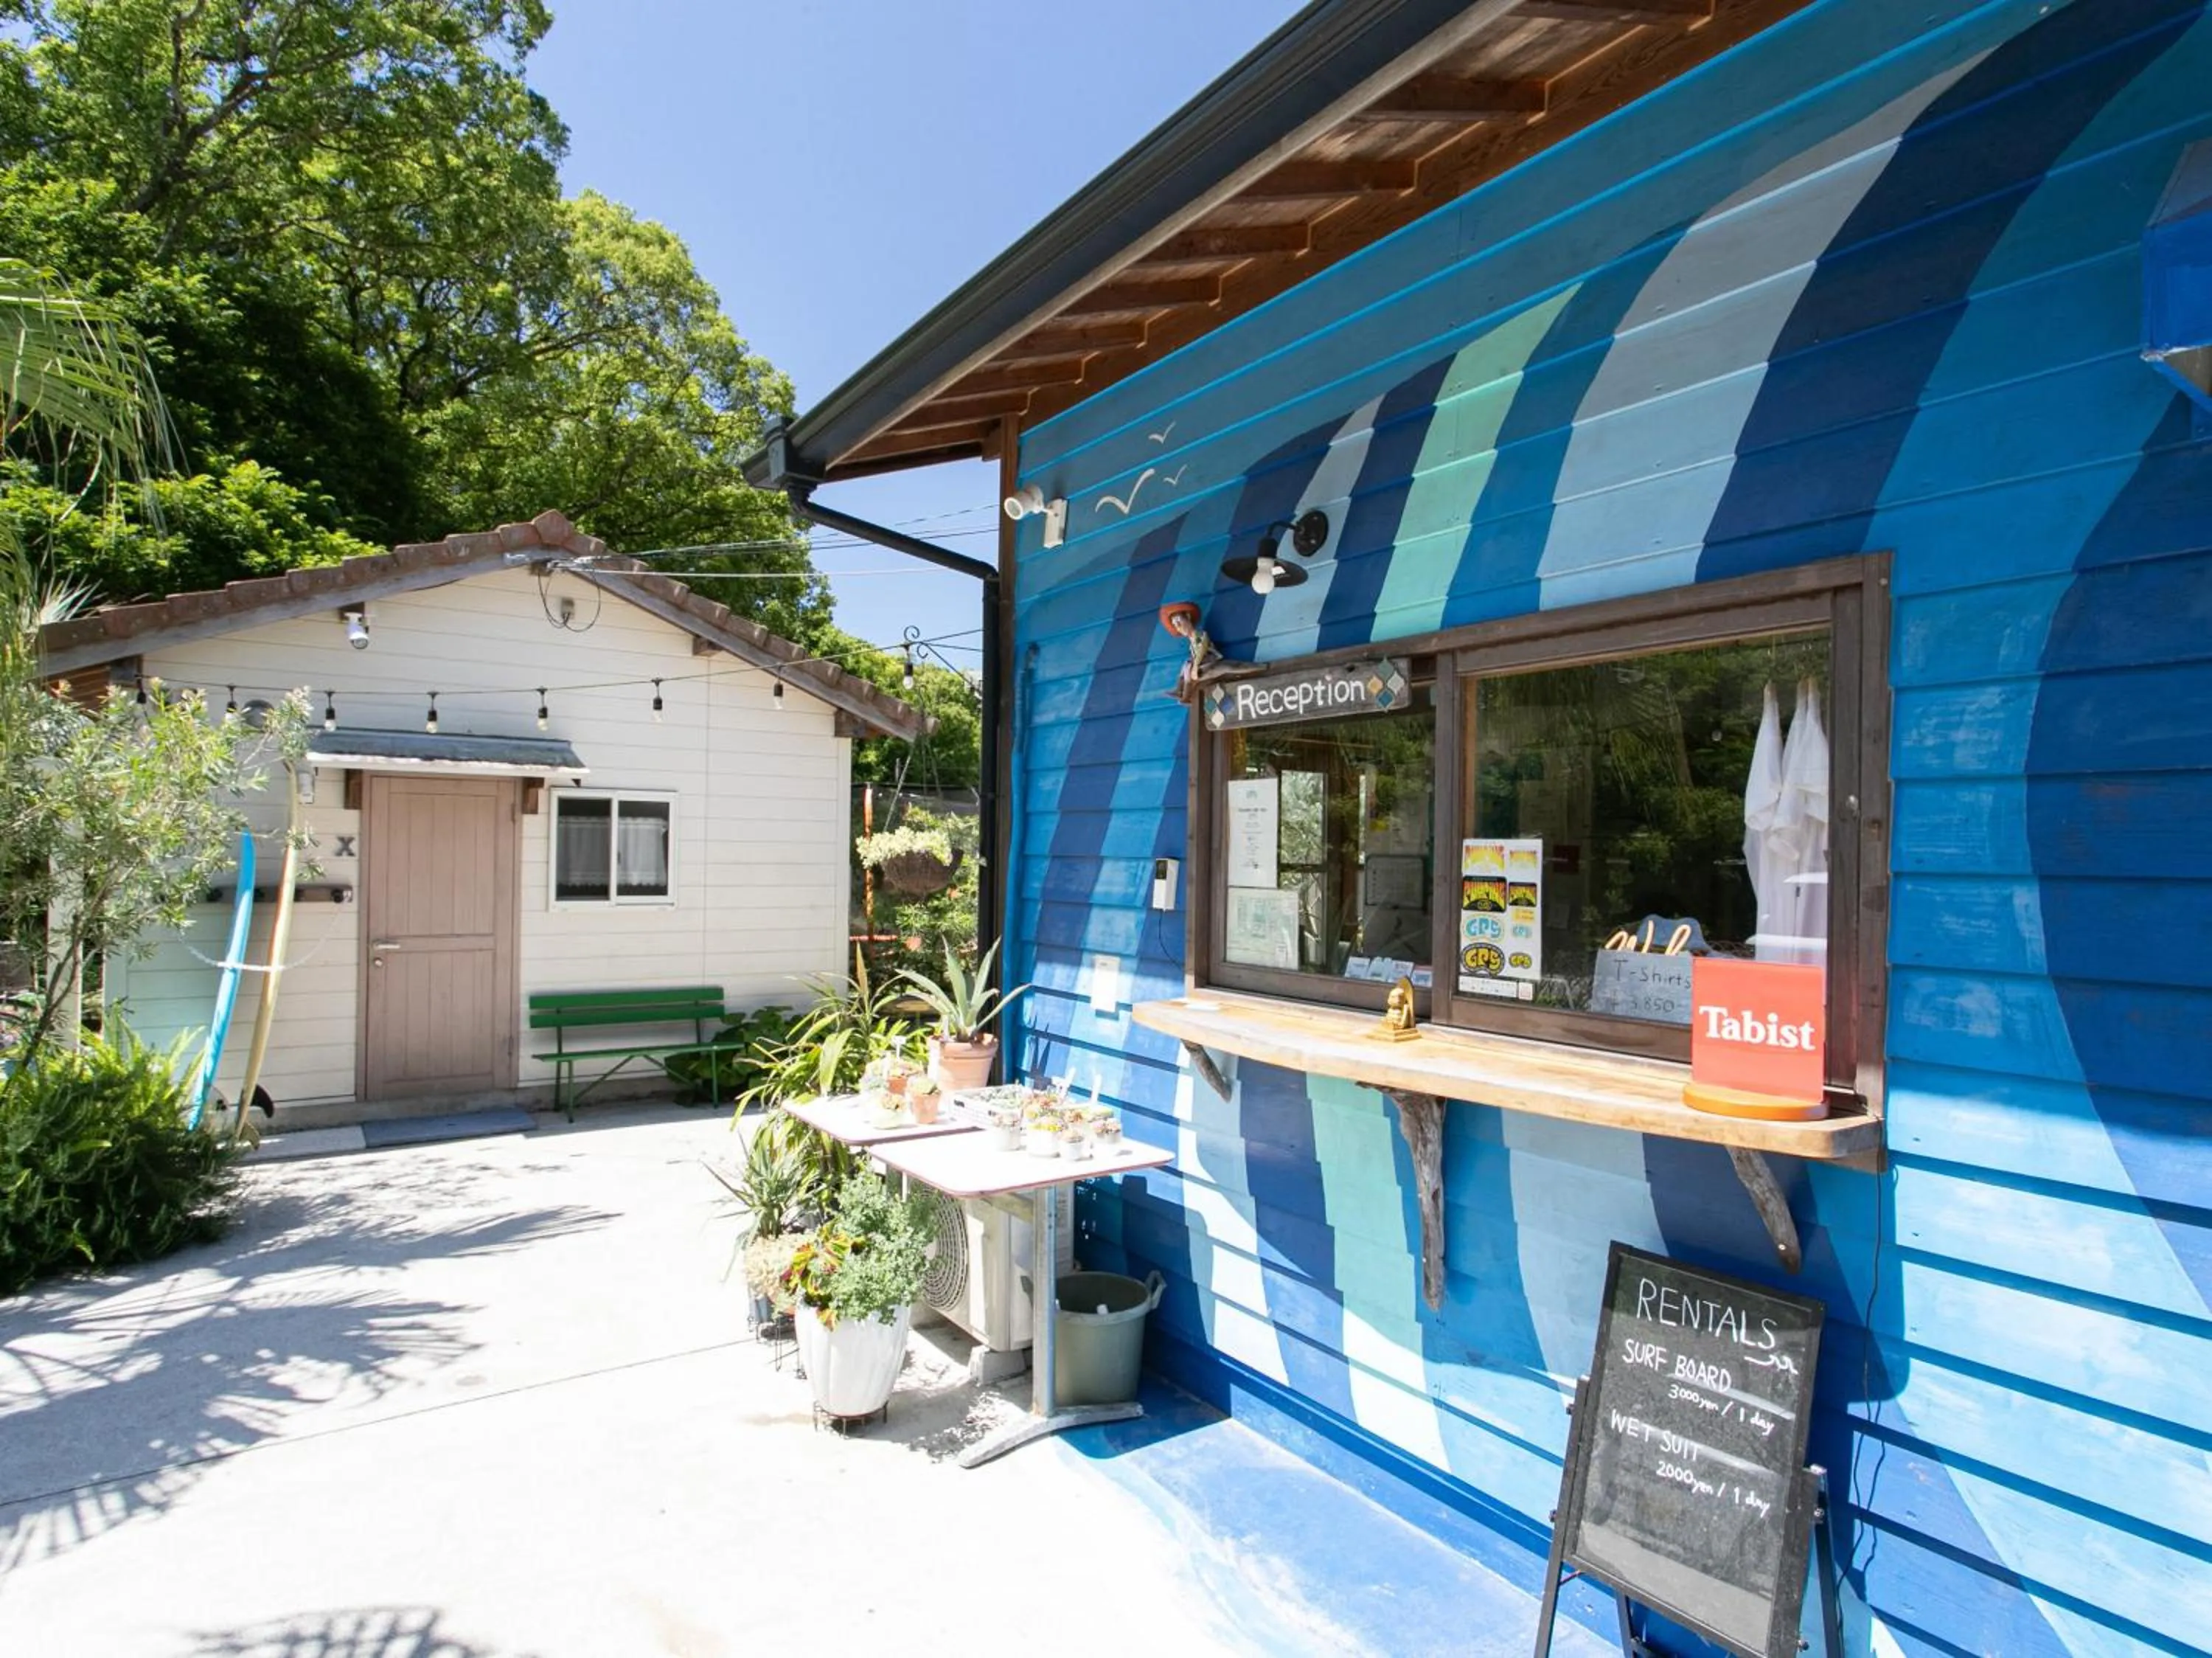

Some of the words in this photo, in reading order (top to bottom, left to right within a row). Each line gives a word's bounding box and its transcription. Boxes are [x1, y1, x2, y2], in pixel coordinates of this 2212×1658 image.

[1237, 674, 1366, 721] Reception
[1464, 947, 1501, 971] GPS
[1699, 1005, 1816, 1051] Tabist
[1637, 1277, 1778, 1350] RENTALS
[1622, 1339, 1668, 1372] SURF
[1674, 1355, 1732, 1392] BOARD
[1610, 1409, 1651, 1443] WET
[1660, 1430, 1700, 1461] SUIT
[1750, 1412, 1775, 1436] day
[1745, 1491, 1770, 1519] day
